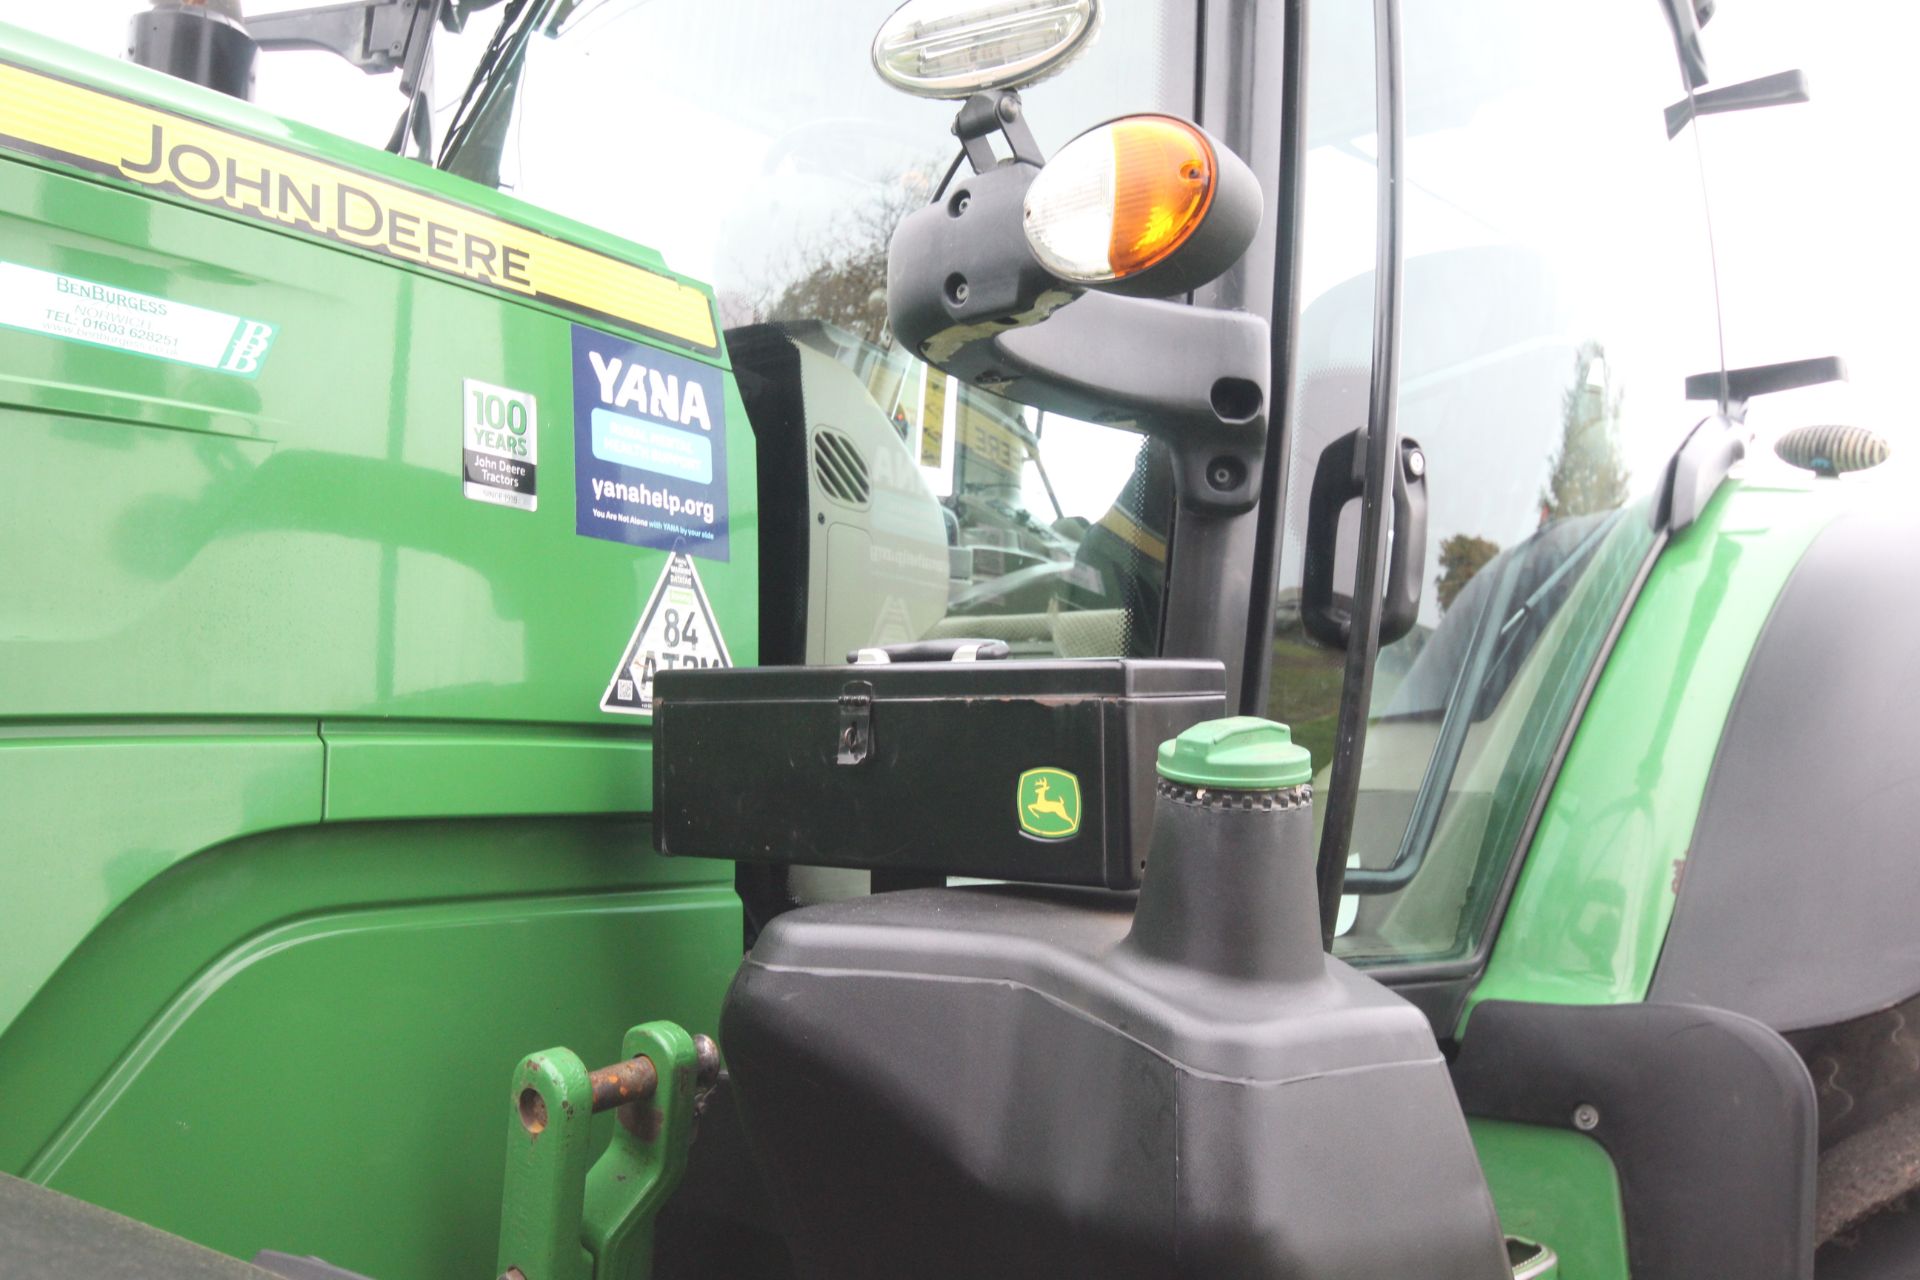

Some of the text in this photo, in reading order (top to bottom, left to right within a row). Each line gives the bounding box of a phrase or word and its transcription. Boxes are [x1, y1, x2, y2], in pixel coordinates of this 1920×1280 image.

[121, 125, 531, 287] JOHN DEERE
[82, 317, 125, 336] 01603
[129, 328, 178, 347] 628251
[589, 351, 711, 431] YANA
[472, 390, 527, 436] 100
[473, 427, 528, 457] YEARS
[474, 454, 526, 477] John Deere
[481, 468, 519, 488] Tractors
[592, 478, 714, 525] yanahelp.org
[592, 508, 714, 540] You Are Not Alone with YANA by your side
[663, 608, 699, 650] 84
